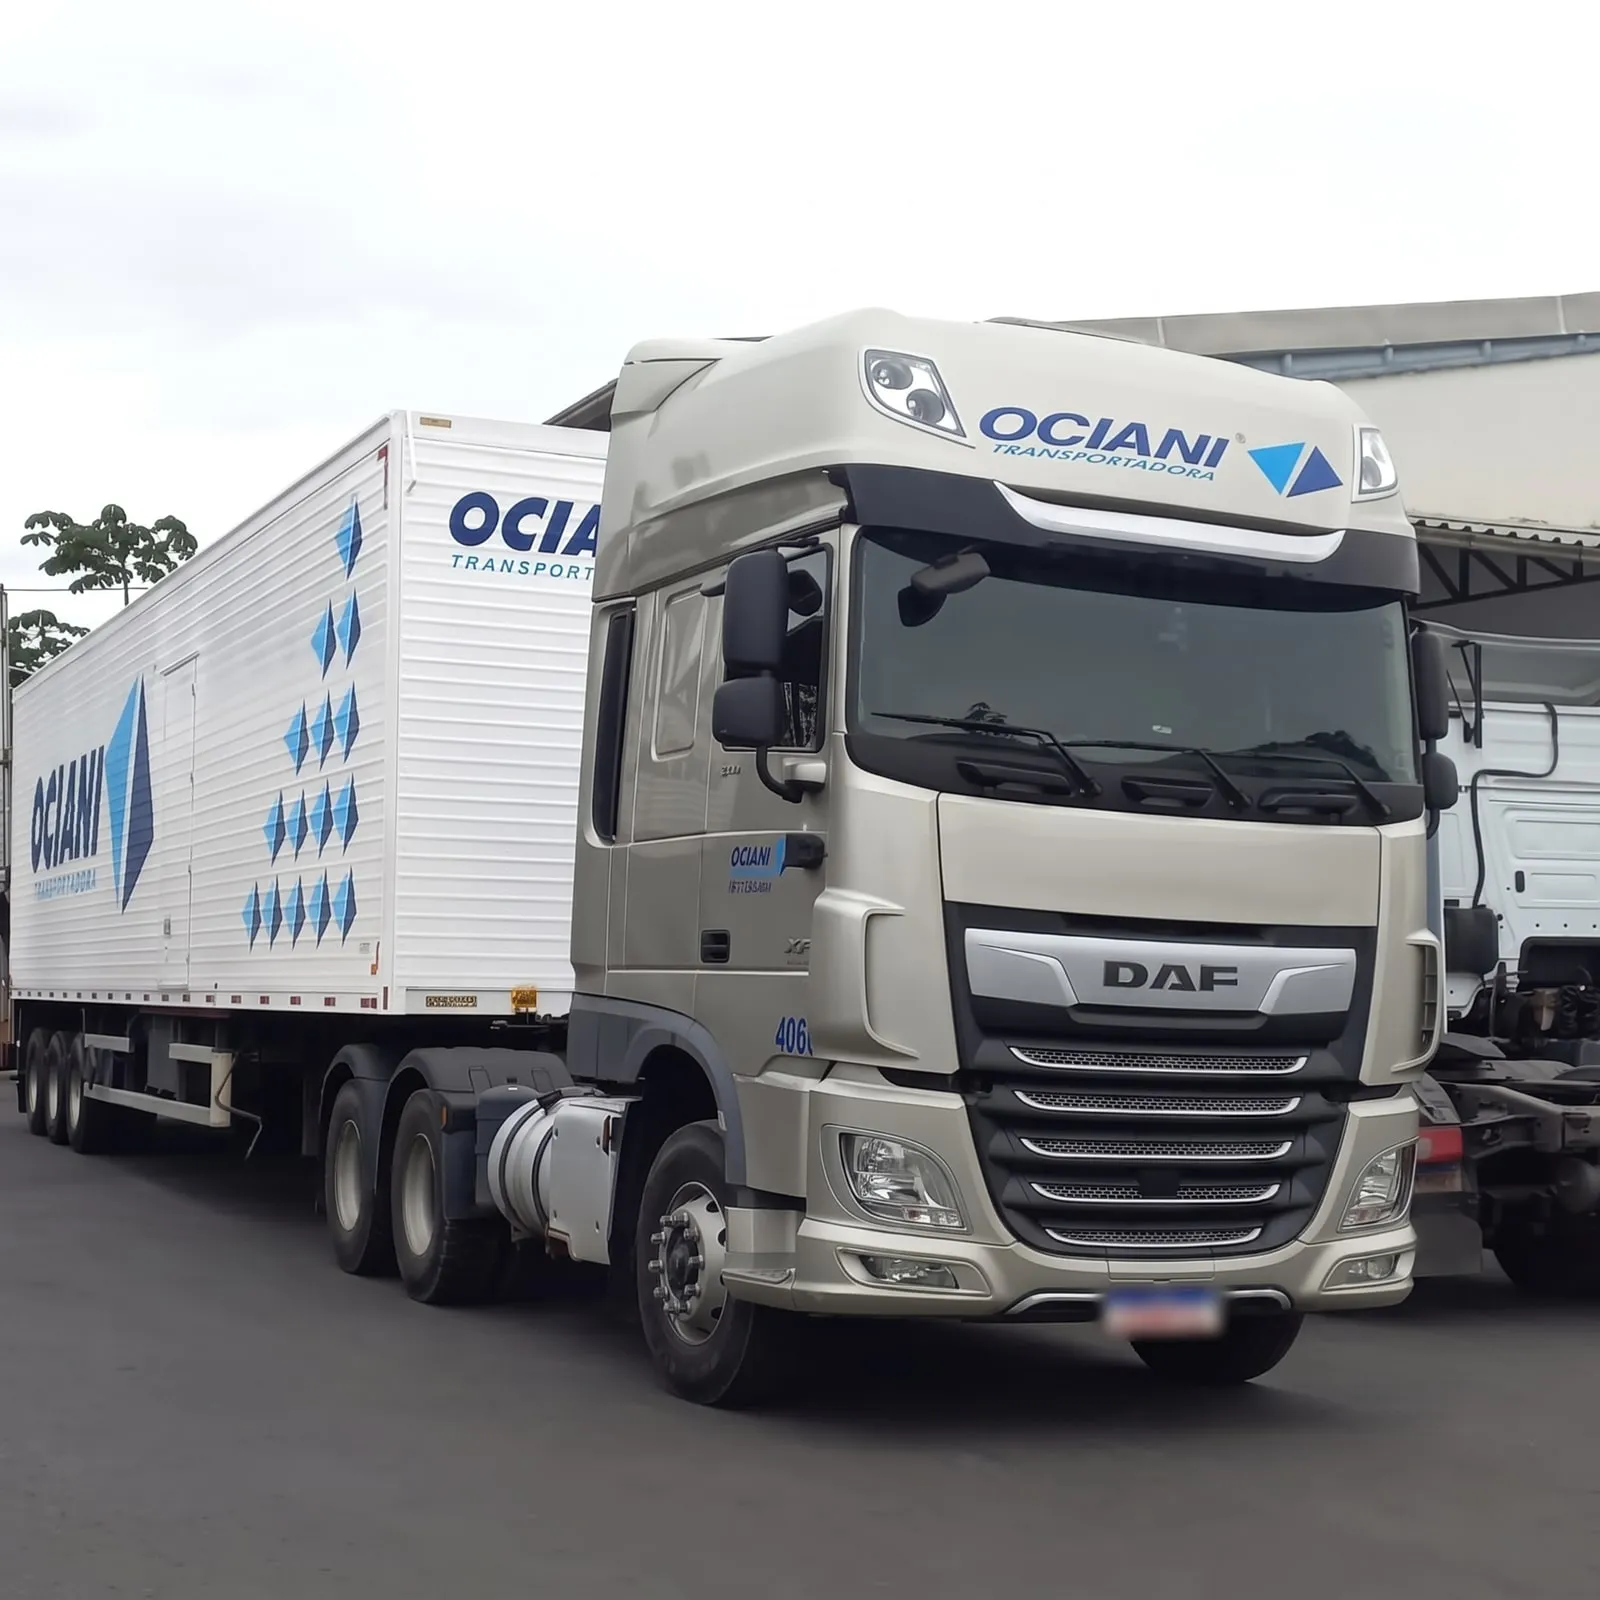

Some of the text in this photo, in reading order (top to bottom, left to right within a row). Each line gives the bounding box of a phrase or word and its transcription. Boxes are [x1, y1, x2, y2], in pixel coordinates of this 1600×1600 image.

[979, 406, 1230, 468] OCIANI
[992, 443, 1215, 481] TRANSPORTADORA
[31, 744, 104, 874] OCIANI
[731, 846, 771, 867] OCIANI
[1103, 960, 1238, 992] DAF
